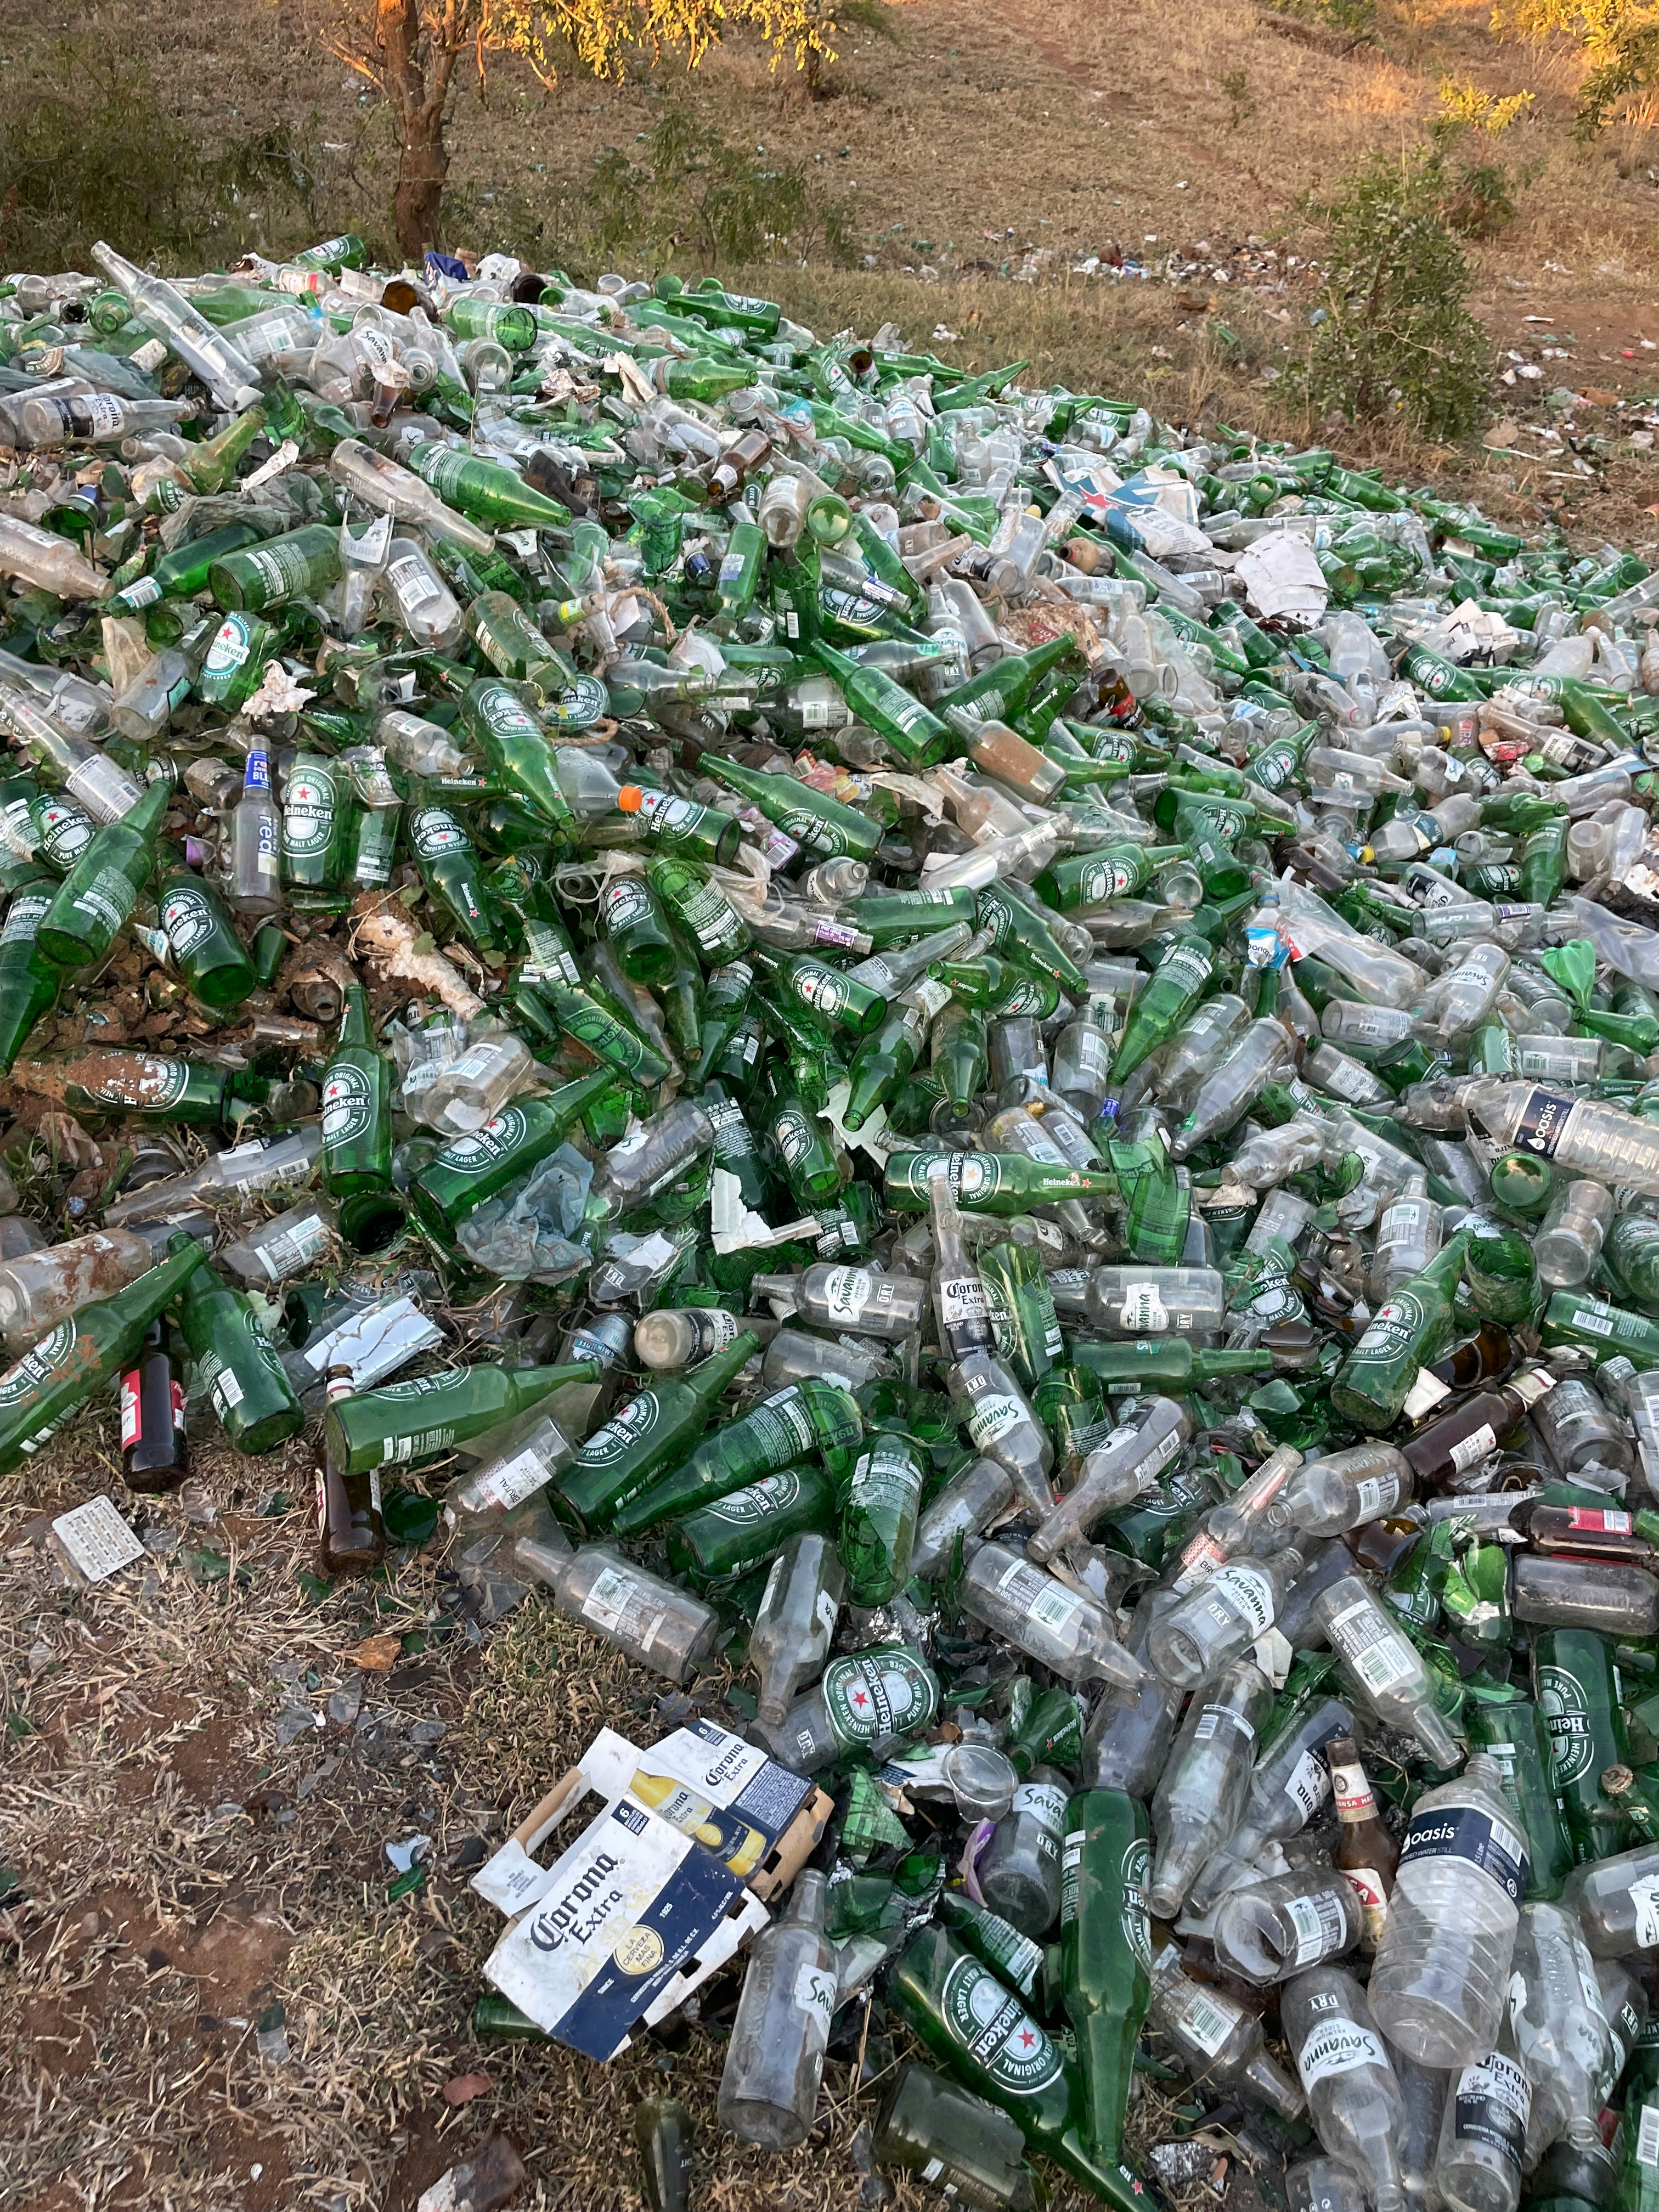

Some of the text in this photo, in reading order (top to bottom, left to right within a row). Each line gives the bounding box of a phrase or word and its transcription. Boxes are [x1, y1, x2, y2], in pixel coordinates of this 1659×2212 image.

[360, 330, 387, 365] Savann
[701, 715, 715, 730] DRY
[306, 774, 330, 801] ORIGINAL
[43, 814, 91, 851] Heineken
[307, 831, 325, 847] LAGER
[58, 850, 74, 860] PURE
[460, 883, 475, 910] Heineken
[1030, 952, 1053, 973] Heineken
[798, 972, 819, 983] ORIGINAL
[334, 1072, 360, 1089] ORIGINAL
[1348, 1077, 1367, 1096] BRUTAL
[340, 1117, 360, 1135] LAGER
[502, 1113, 515, 1139] ORIGINAL
[1535, 1101, 1557, 1139] oasis
[472, 1129, 500, 1155] neken
[455, 1154, 478, 1164] LAGER
[926, 1153, 940, 1165] PURE
[969, 1175, 994, 1200] ORIGINAL
[854, 1279, 862, 1300] PREMIUM
[877, 1283, 890, 1304] DRY
[946, 1281, 984, 1300] Coron
[961, 1294, 985, 1306] Extra
[1268, 1311, 1285, 1323] MALT
[1394, 1297, 1412, 1321] ORIGINAL
[1177, 1313, 1192, 1329] DRY
[1370, 1344, 1392, 1356] LAGER
[964, 1374, 988, 1395] DRY
[635, 1397, 648, 1424] ORIGINAL
[971, 1400, 1020, 1441] Savanna
[586, 1446, 610, 1457] LAGER
[499, 1477, 522, 1503] BRUTAL
[721, 1502, 746, 1514] LAGER
[1219, 1568, 1267, 1627] Savanna
[1207, 1601, 1232, 1628] DRY
[1331, 1628, 1342, 1643] 330
[889, 1659, 920, 1722] AGER PURE
[1555, 1678, 1572, 1698] PURE
[837, 1669, 871, 1734] HEINEKEN ORIGINAL
[865, 1659, 893, 1739] Heineken
[698, 1726, 708, 1735] 6
[1053, 1718, 1077, 1742] Heineken
[1549, 1716, 1585, 1734] Hein
[704, 1742, 744, 1787] Corona
[725, 1757, 748, 1782] Extra
[1022, 1788, 1064, 1815] Sava
[619, 1808, 630, 1819] 6
[673, 1807, 693, 1824] Extra
[1411, 1822, 1455, 1846] oasis
[1036, 1833, 1058, 1858] DRY
[1417, 1846, 1452, 1857] WATER STILL
[530, 1853, 619, 1952] Corona
[568, 1888, 624, 1945] Extra
[623, 1932, 652, 1966] CERVEZA
[625, 1938, 637, 1949] LA
[635, 1945, 651, 1962] MAS
[641, 1950, 657, 1968] FINA
[956, 1969, 979, 2023] MALT LAGER
[1310, 1993, 1340, 2011] DRY
[979, 1994, 1018, 2056] eineken
[1304, 2035, 1375, 2071] Savanna
[1493, 2072, 1525, 2104] Extra
